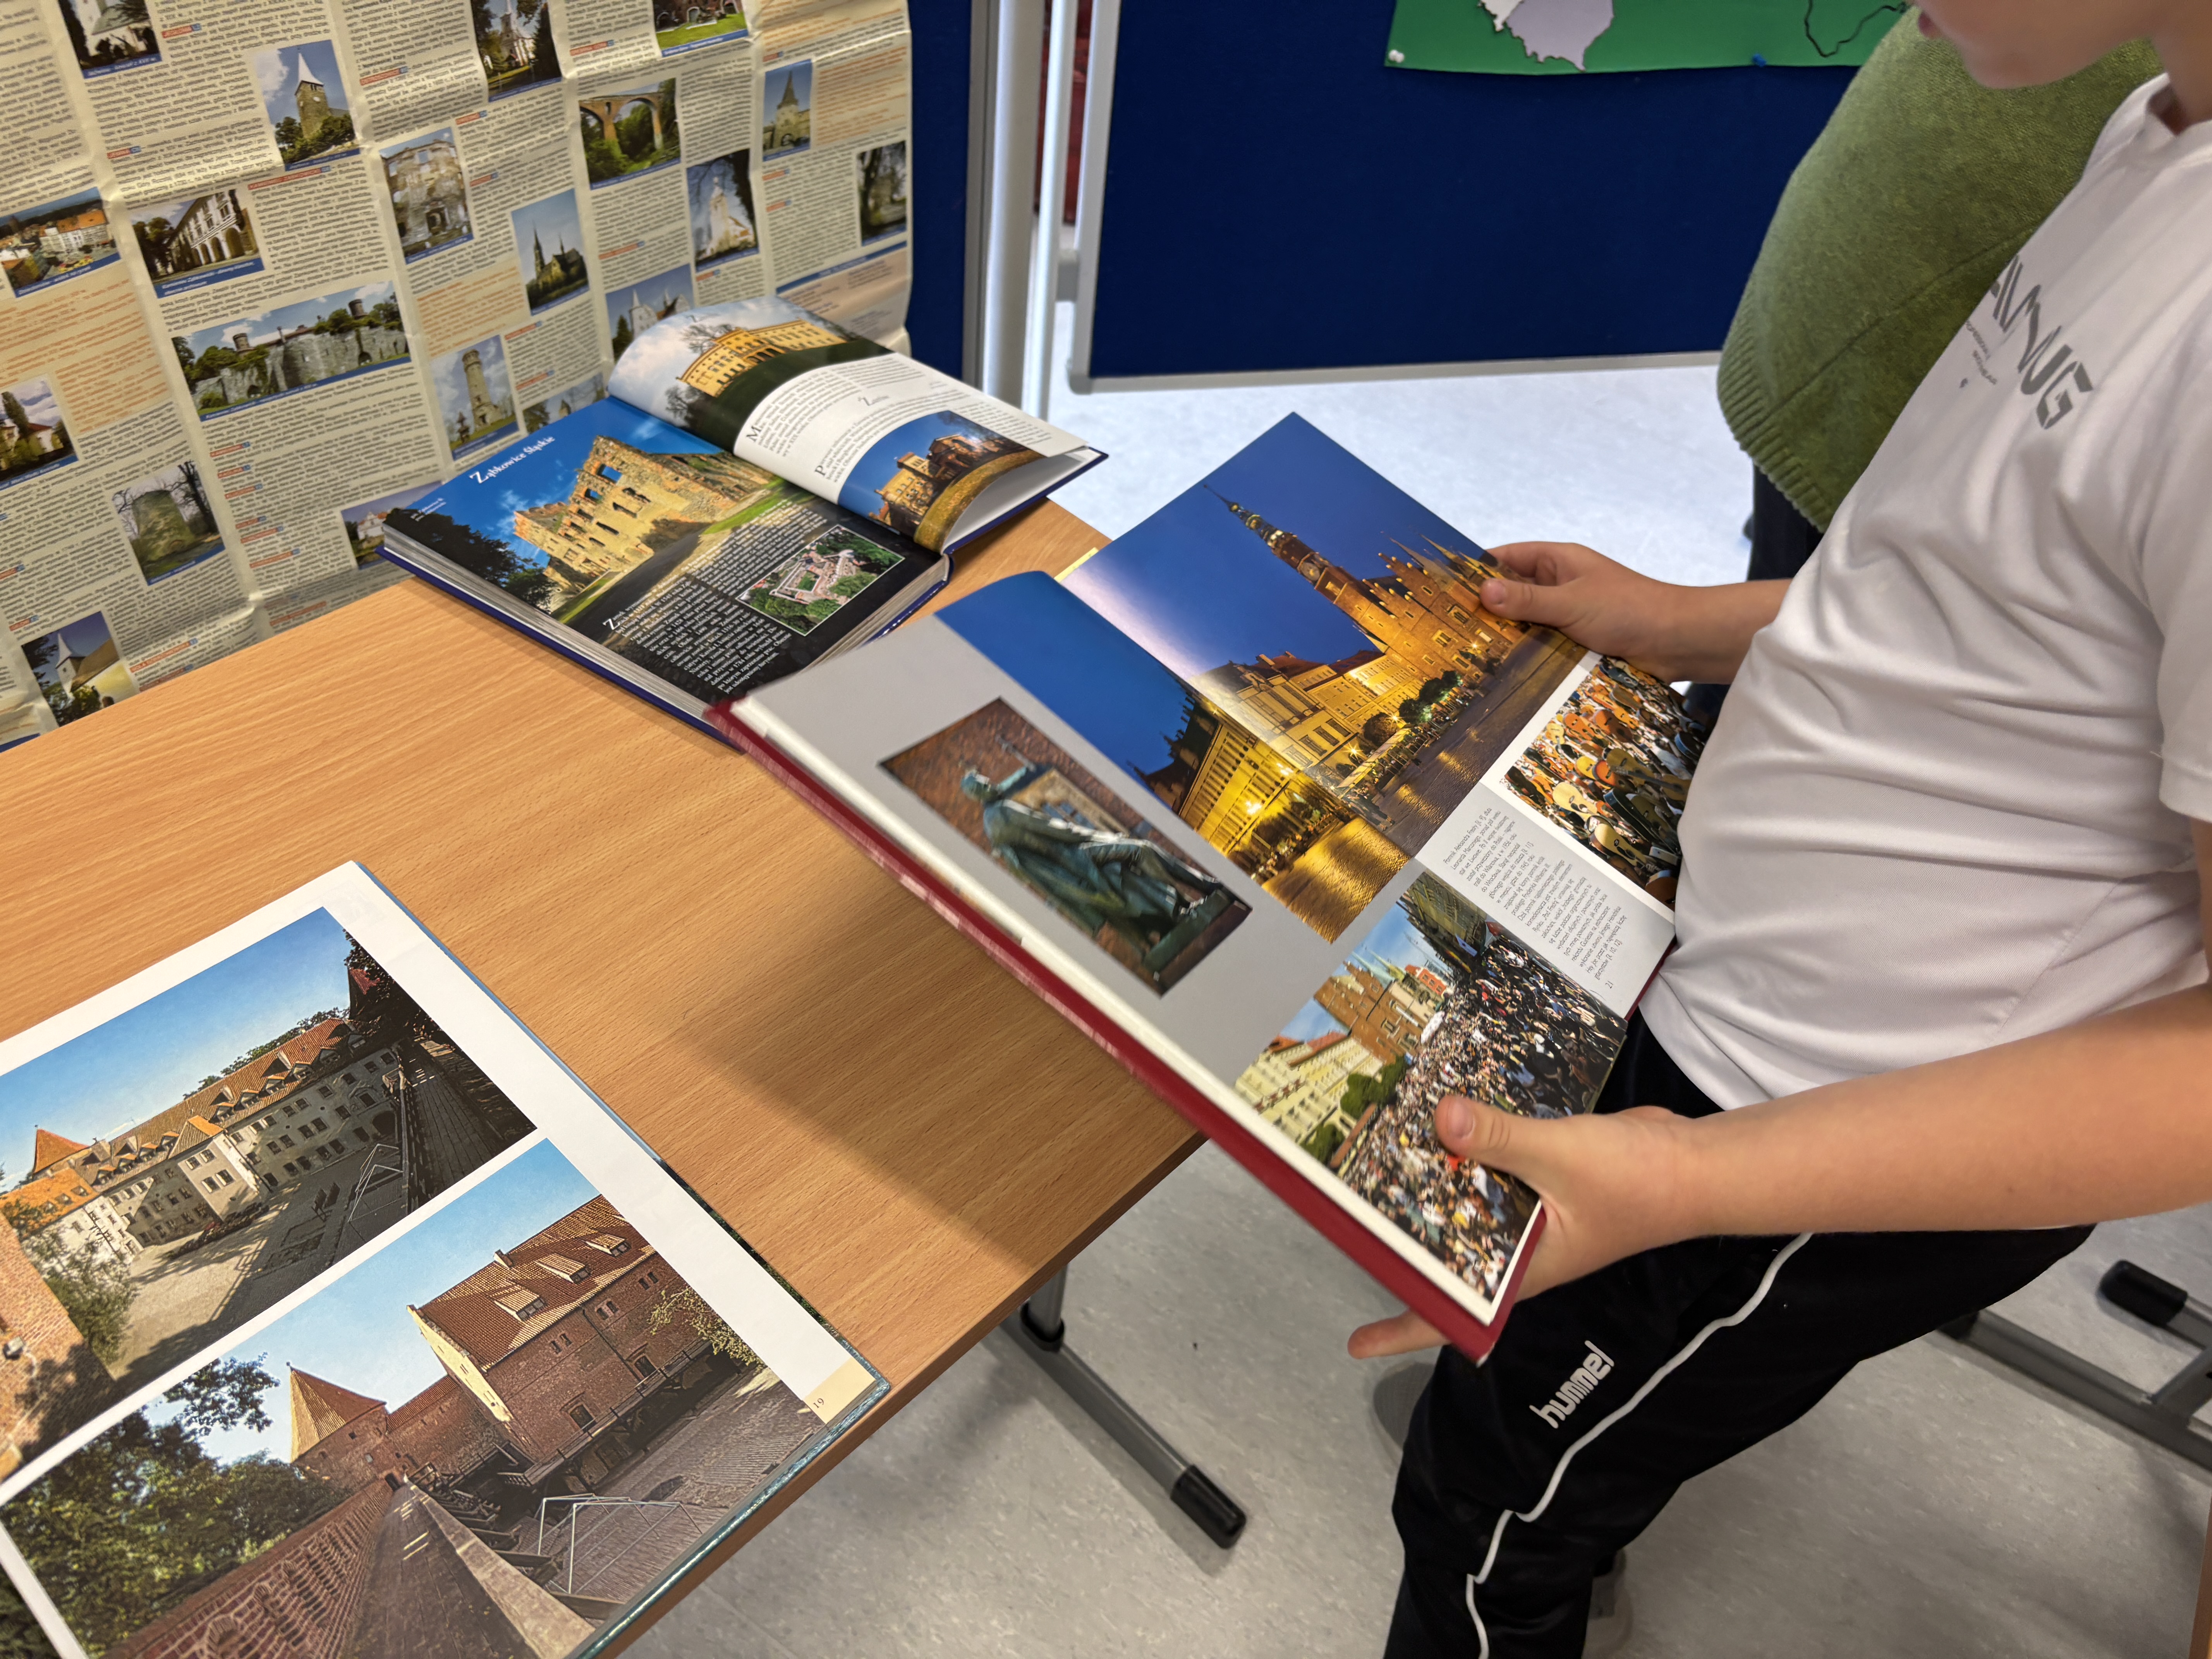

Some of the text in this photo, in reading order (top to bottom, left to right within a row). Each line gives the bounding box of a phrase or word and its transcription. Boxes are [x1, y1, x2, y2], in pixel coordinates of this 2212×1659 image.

[469, 453, 526, 483] Ząbkowice
[1606, 981, 1613, 989] 21
[1529, 1340, 1614, 1429] hummel
[812, 1397, 824, 1409] 19
